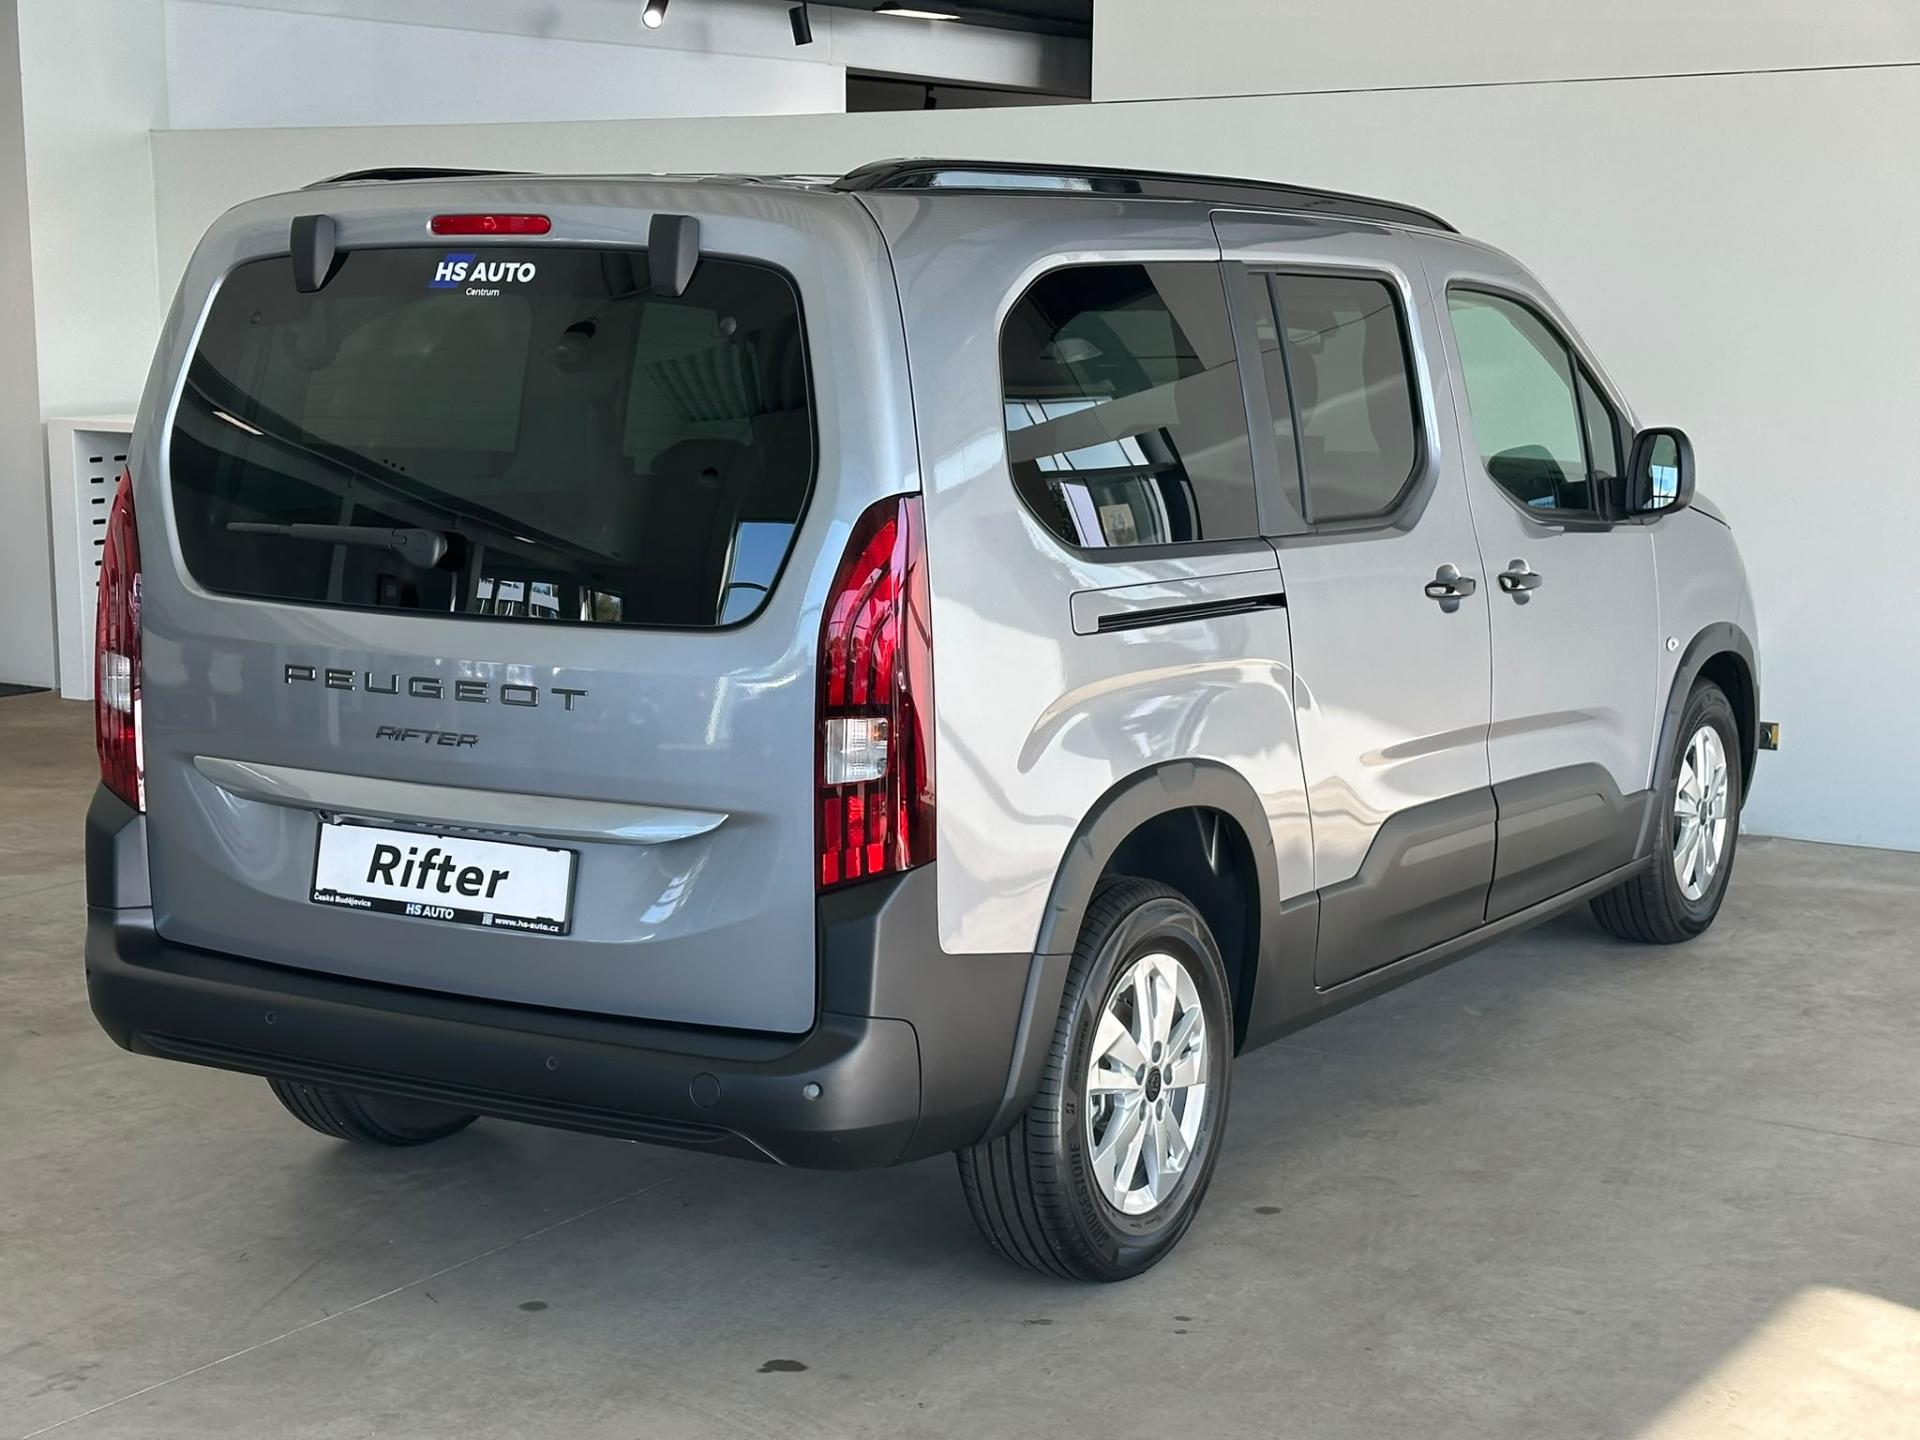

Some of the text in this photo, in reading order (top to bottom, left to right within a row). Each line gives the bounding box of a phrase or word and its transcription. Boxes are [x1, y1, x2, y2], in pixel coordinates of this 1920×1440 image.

[435, 262, 536, 283] HS AUTO
[465, 287, 500, 296] Centrum
[284, 664, 589, 711] PEUGEOT
[375, 727, 479, 749] RIFTER
[367, 844, 510, 898] Rifter
[314, 892, 334, 903] České
[406, 903, 454, 920] HS AUTO
[494, 917, 559, 932] www.hs-auto.cz
